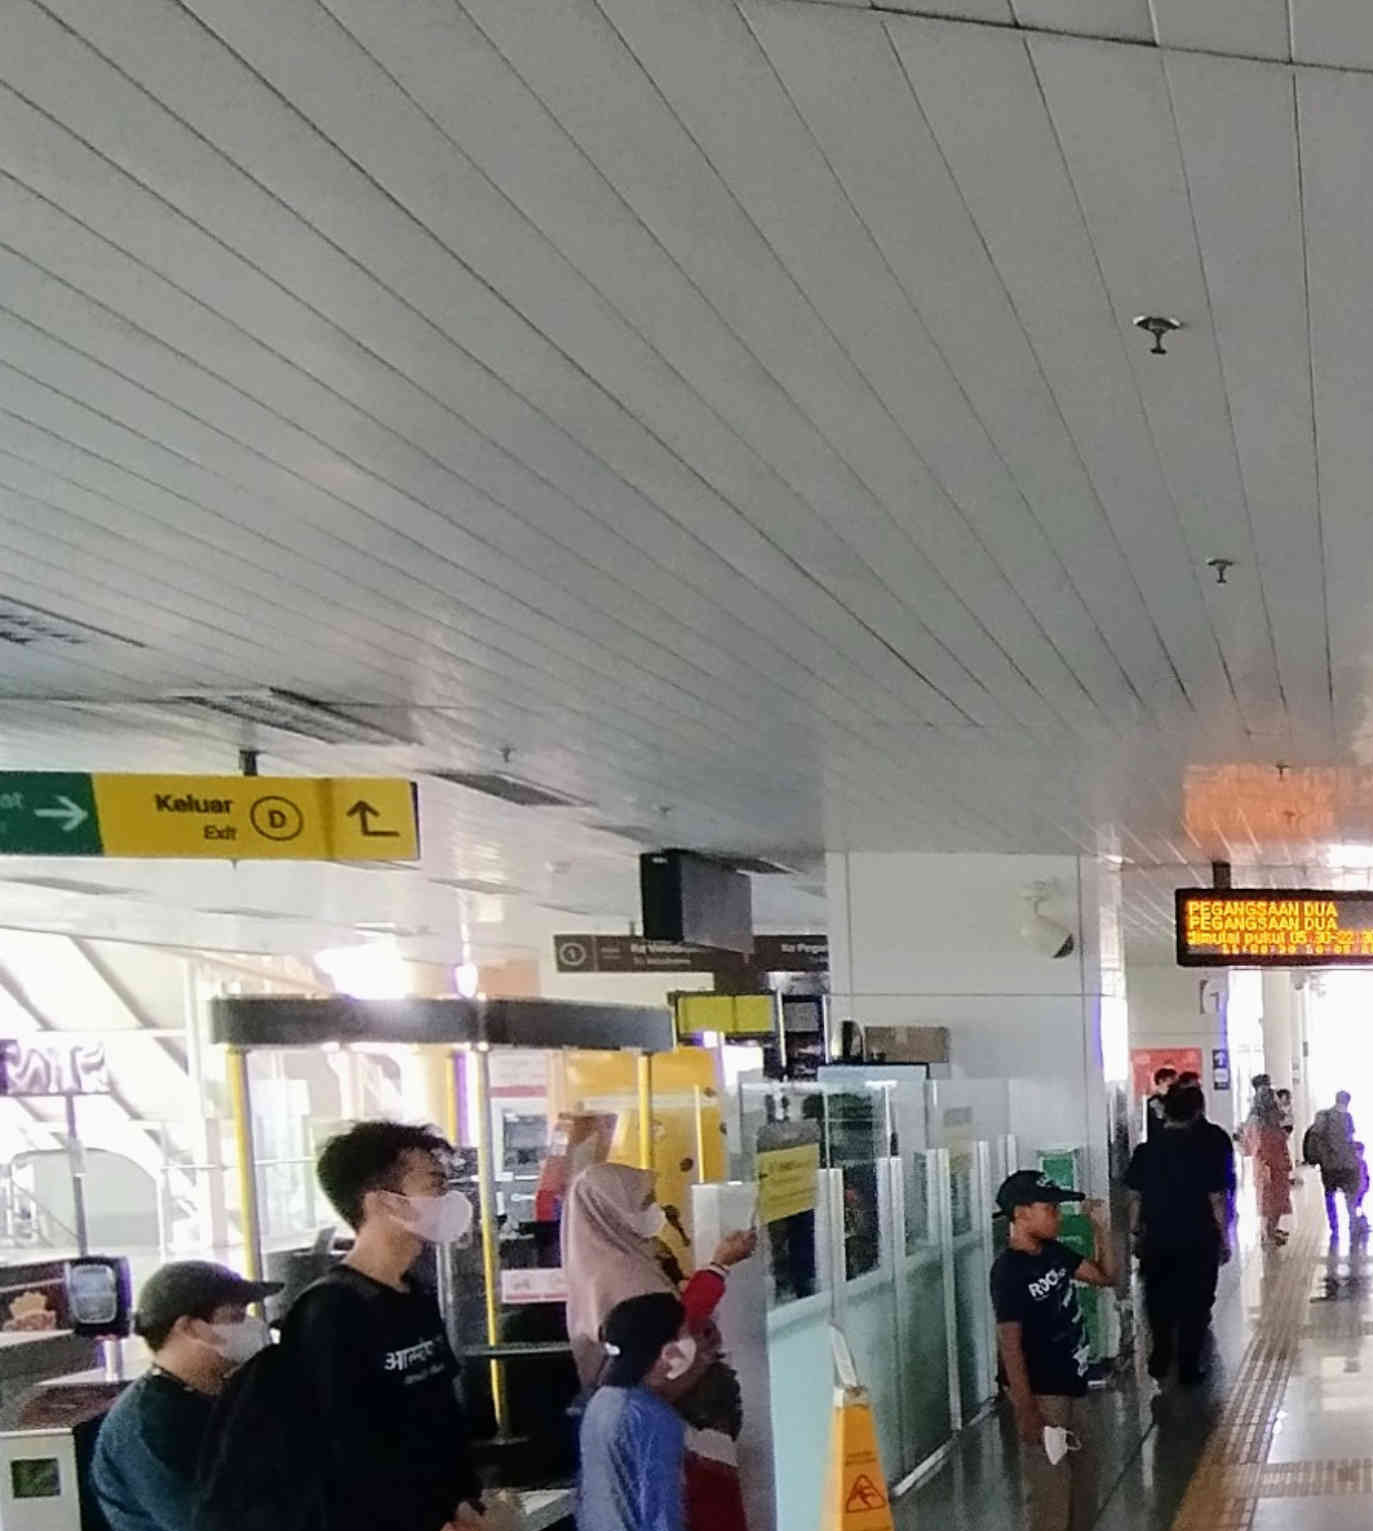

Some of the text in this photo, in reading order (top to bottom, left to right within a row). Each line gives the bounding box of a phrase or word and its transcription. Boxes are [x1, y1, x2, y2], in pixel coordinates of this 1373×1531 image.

[154, 793, 234, 814] Keluar
[269, 810, 287, 829] D
[203, 824, 237, 841] Exit
[1188, 901, 1339, 917] PEGANGSAAN DUA
[1188, 917, 1339, 931] PEGANGSAAN DUA
